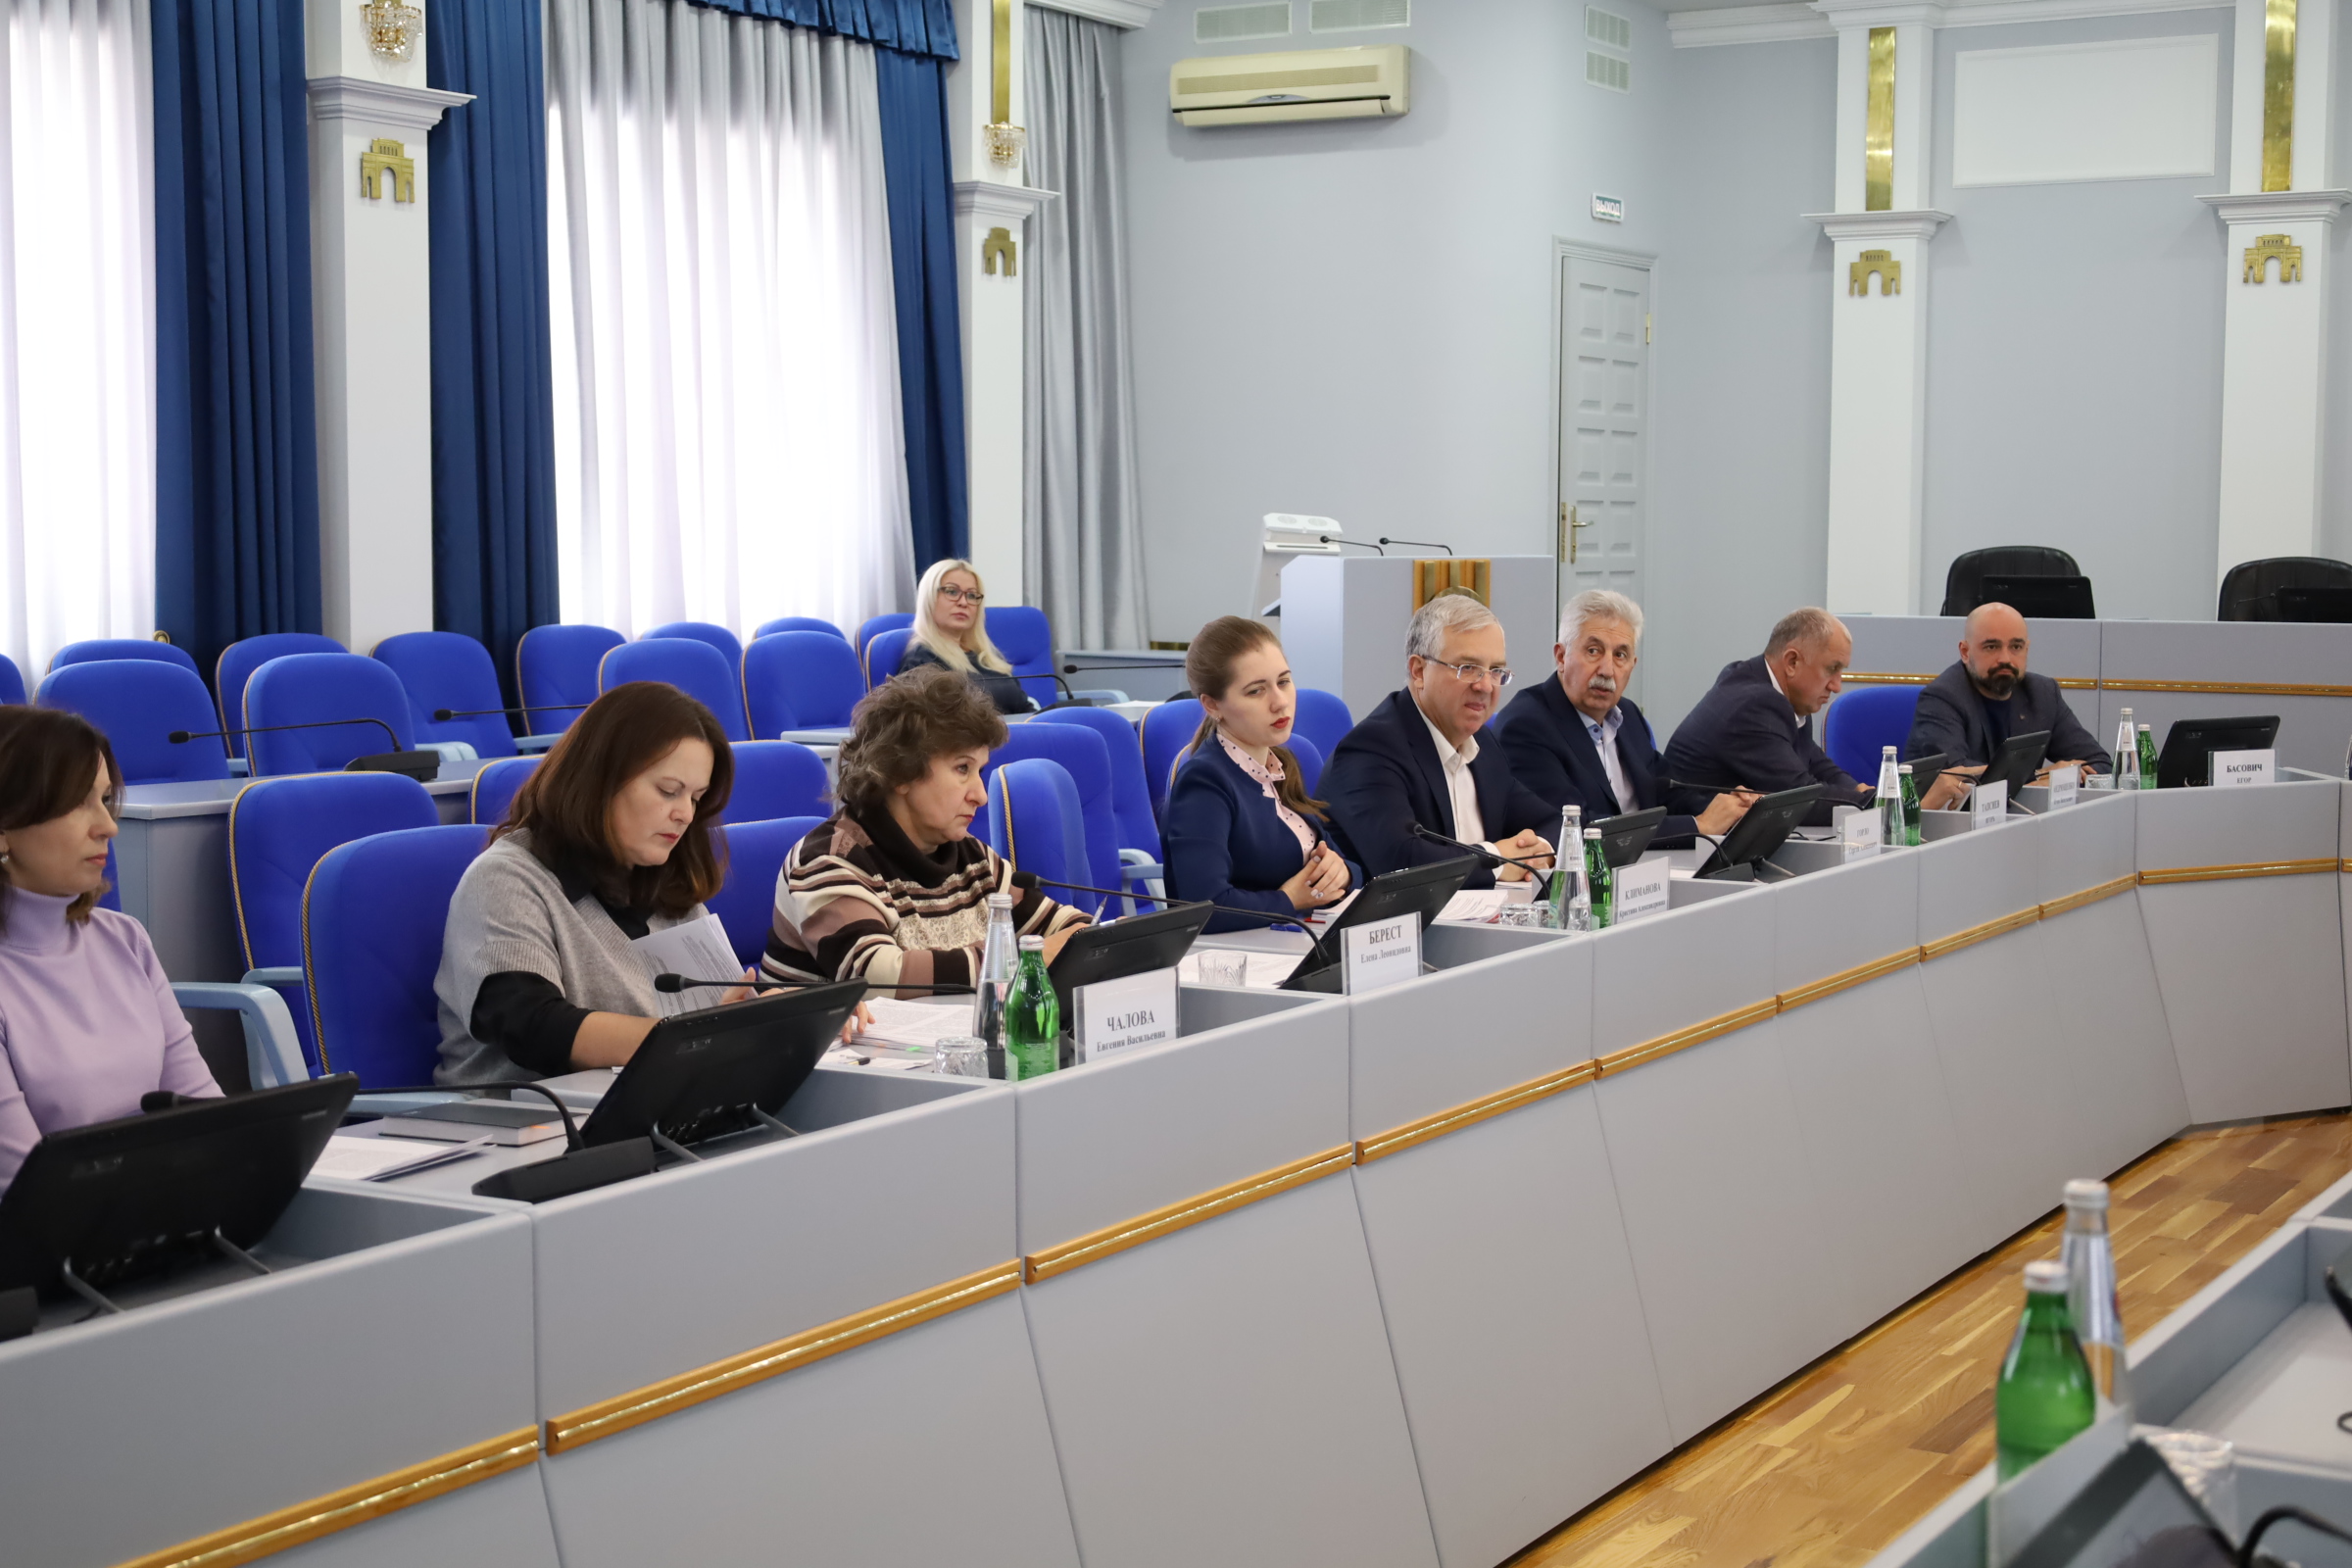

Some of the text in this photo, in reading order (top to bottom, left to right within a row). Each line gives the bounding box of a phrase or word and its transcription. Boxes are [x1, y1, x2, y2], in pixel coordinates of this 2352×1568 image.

[1595, 199, 1621, 217] ВЫХОД
[2226, 763, 2263, 773] БАСОВИЧ
[1625, 882, 1661, 901] КЛИМАНОВА
[1369, 924, 1402, 945] БЕРЕСТ
[1360, 945, 1411, 963] Елена Леонидовна
[1106, 1009, 1155, 1032] ЧАЛОВА
[1097, 1030, 1166, 1053] Евгения Васильевна
